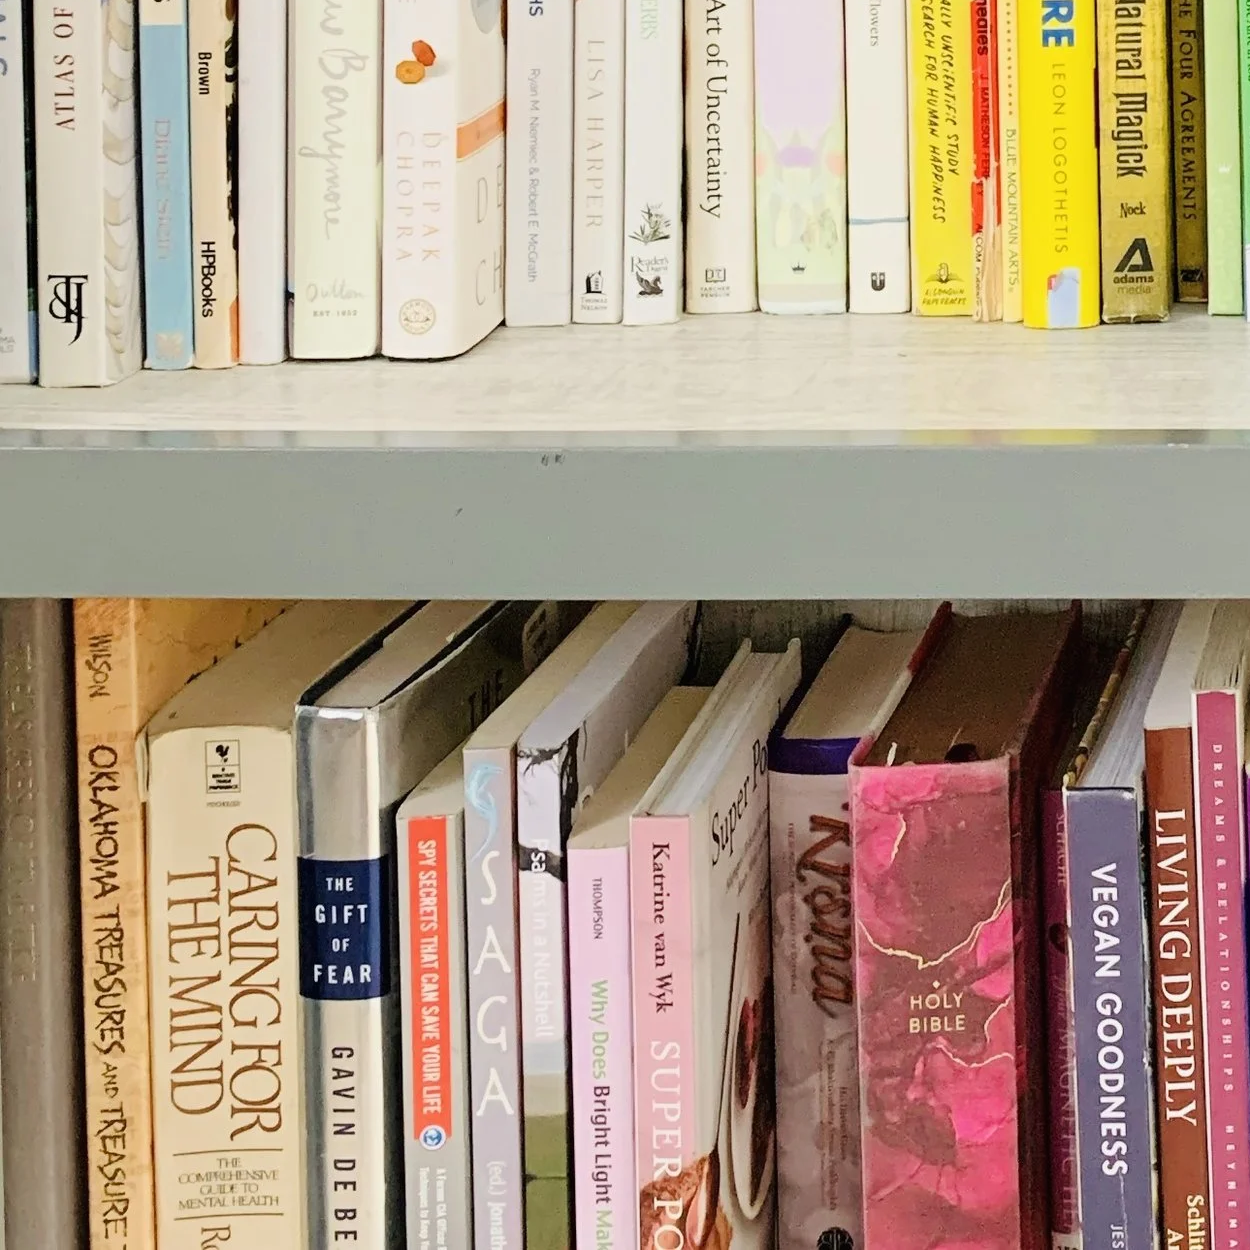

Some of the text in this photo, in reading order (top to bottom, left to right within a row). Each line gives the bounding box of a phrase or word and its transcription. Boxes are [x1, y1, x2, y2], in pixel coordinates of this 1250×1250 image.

[705, 41, 728, 68] of
[699, 73, 729, 220] Uncertainty
[1111, 91, 1149, 179] Magick
[325, 877, 354, 892] THE
[314, 904, 368, 923] GIFT
[331, 937, 350, 952] OF
[313, 963, 372, 984] FEAR
[1154, 808, 1198, 1128] LIVING DEEPLY
[166, 854, 225, 1116] THE MIND
[224, 822, 283, 1142] CARING FOR
[909, 991, 965, 1011] HOLY
[908, 1015, 966, 1034] BIBLE
[1090, 862, 1129, 1177] VEGAN GOODNESS
